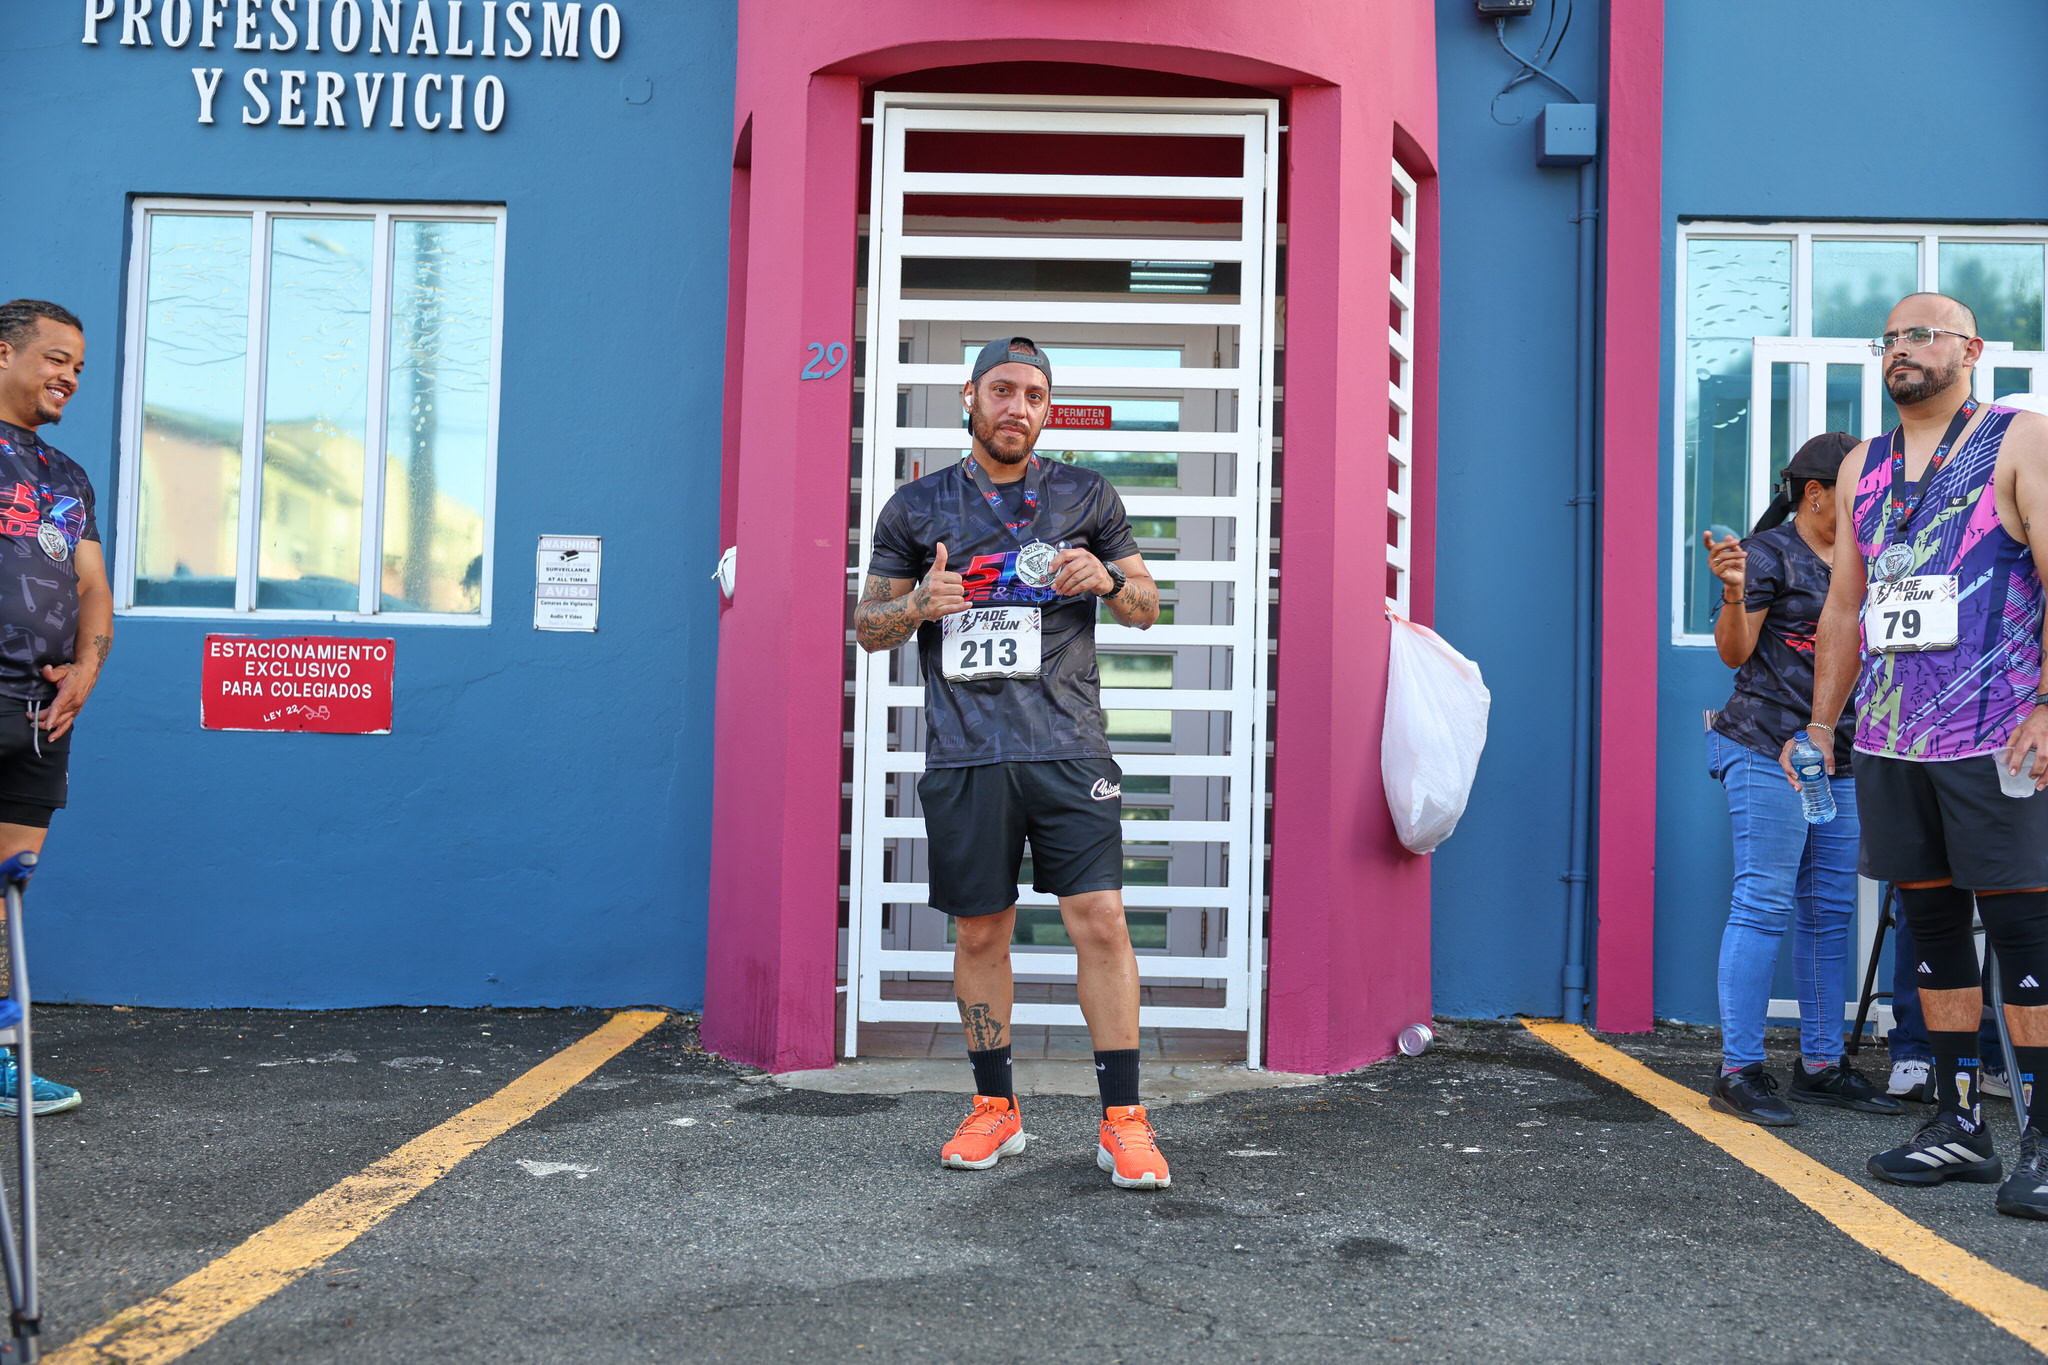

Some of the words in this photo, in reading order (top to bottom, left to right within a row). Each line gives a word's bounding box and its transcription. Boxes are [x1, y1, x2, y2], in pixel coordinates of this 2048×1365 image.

[81, 0, 621, 59] PROFESIONALISMO
[191, 67, 224, 124] Y
[242, 68, 506, 131] SERVICIO
[801, 342, 848, 380] 29
[1058, 407, 1105, 418] PERMITEN
[1055, 417, 1063, 425] NI
[1065, 418, 1105, 426] COLECTAS
[0, 519, 40, 538] DE
[542, 539, 597, 550] WARNING
[545, 585, 590, 597] AVISO
[992, 586, 1010, 601] &
[1889, 579, 1922, 592] FADE
[1904, 590, 1934, 602] RUN
[974, 609, 1009, 622] FADE
[982, 622, 990, 631] &
[990, 621, 1020, 631] RUN
[1883, 609, 1921, 640] 79
[210, 641, 387, 661] ESTACIONAMIENTO
[960, 638, 1018, 669] 213
[1785, 639, 1816, 652] FA
[245, 661, 351, 678] EXCLUSIVO
[222, 680, 263, 697] PARA
[270, 681, 373, 699] COLEGIADOS
[263, 709, 282, 723] LEY
[286, 704, 299, 716] 22
